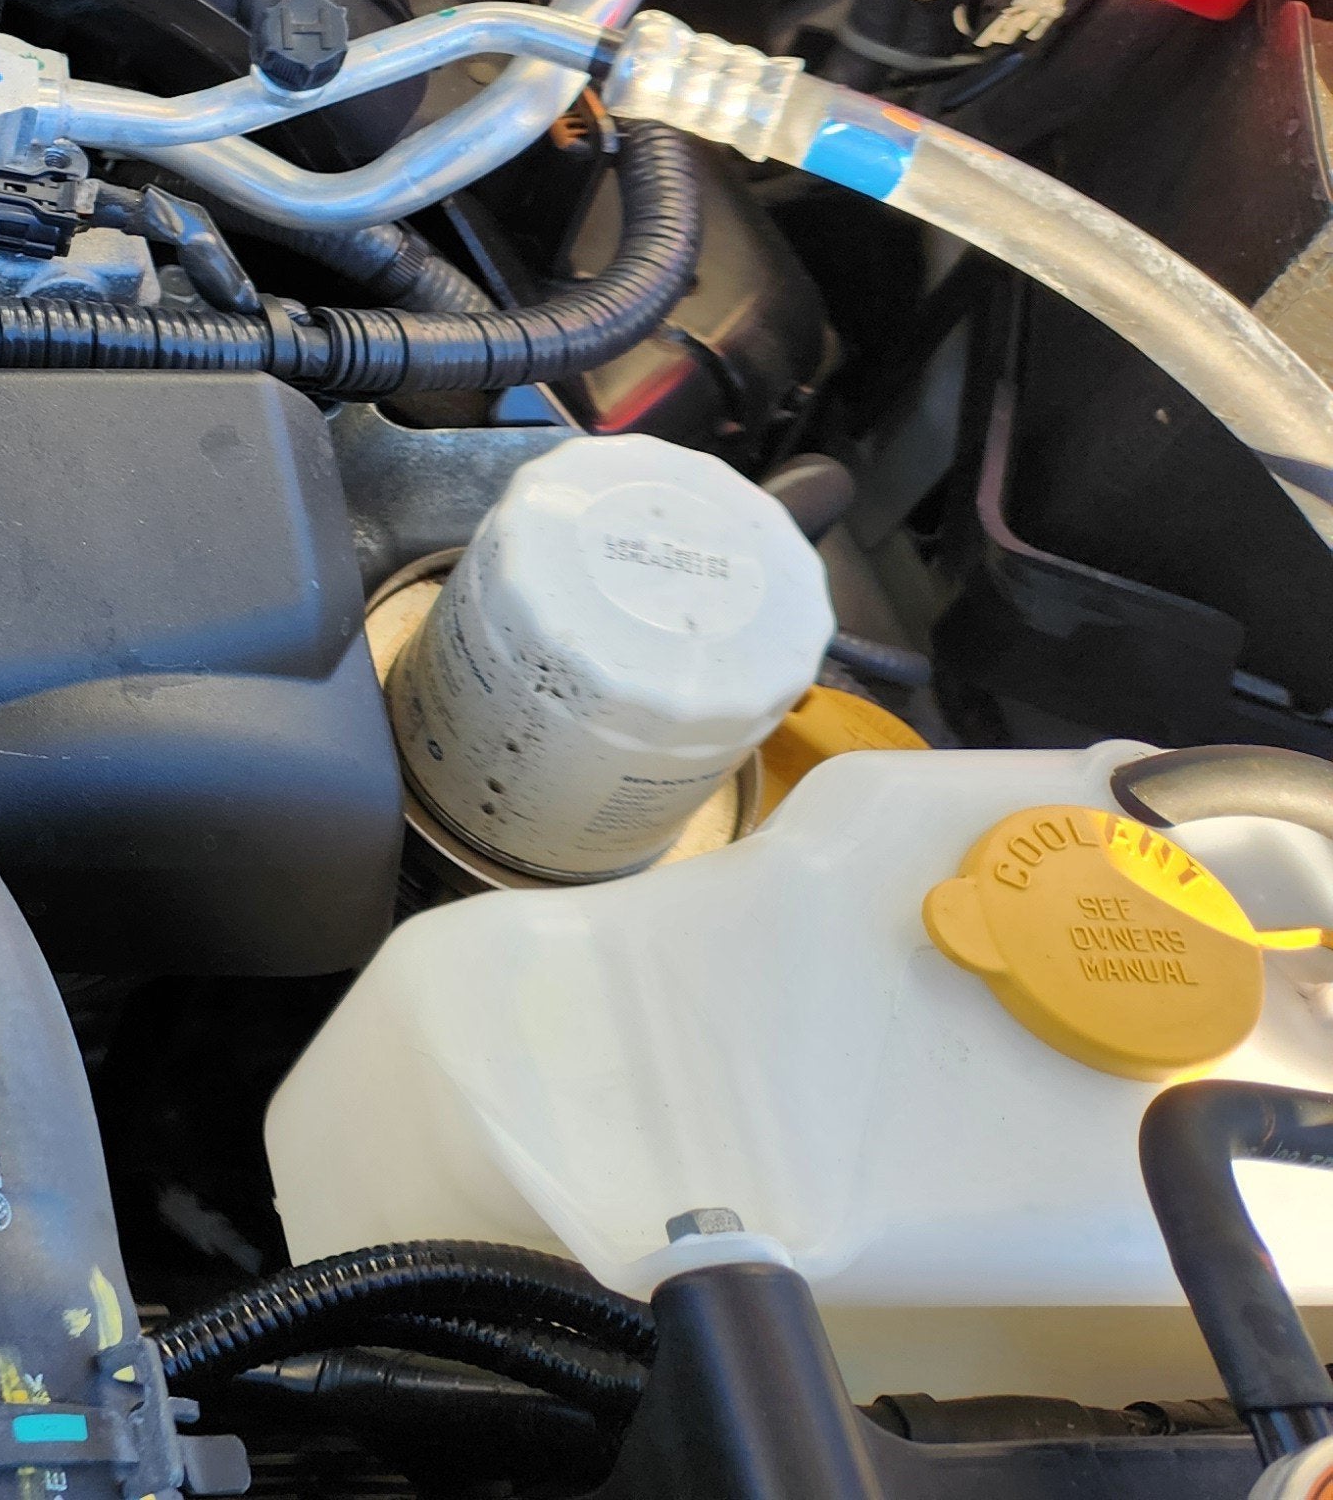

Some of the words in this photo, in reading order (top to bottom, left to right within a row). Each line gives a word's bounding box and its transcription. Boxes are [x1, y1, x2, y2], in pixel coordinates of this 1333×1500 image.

[281, 6, 333, 51] H
[994, 815, 1209, 891] COOLANT
[1077, 896, 1135, 921] SEE
[1070, 926, 1186, 954] OWNERS
[1079, 957, 1199, 986] MANUAL
